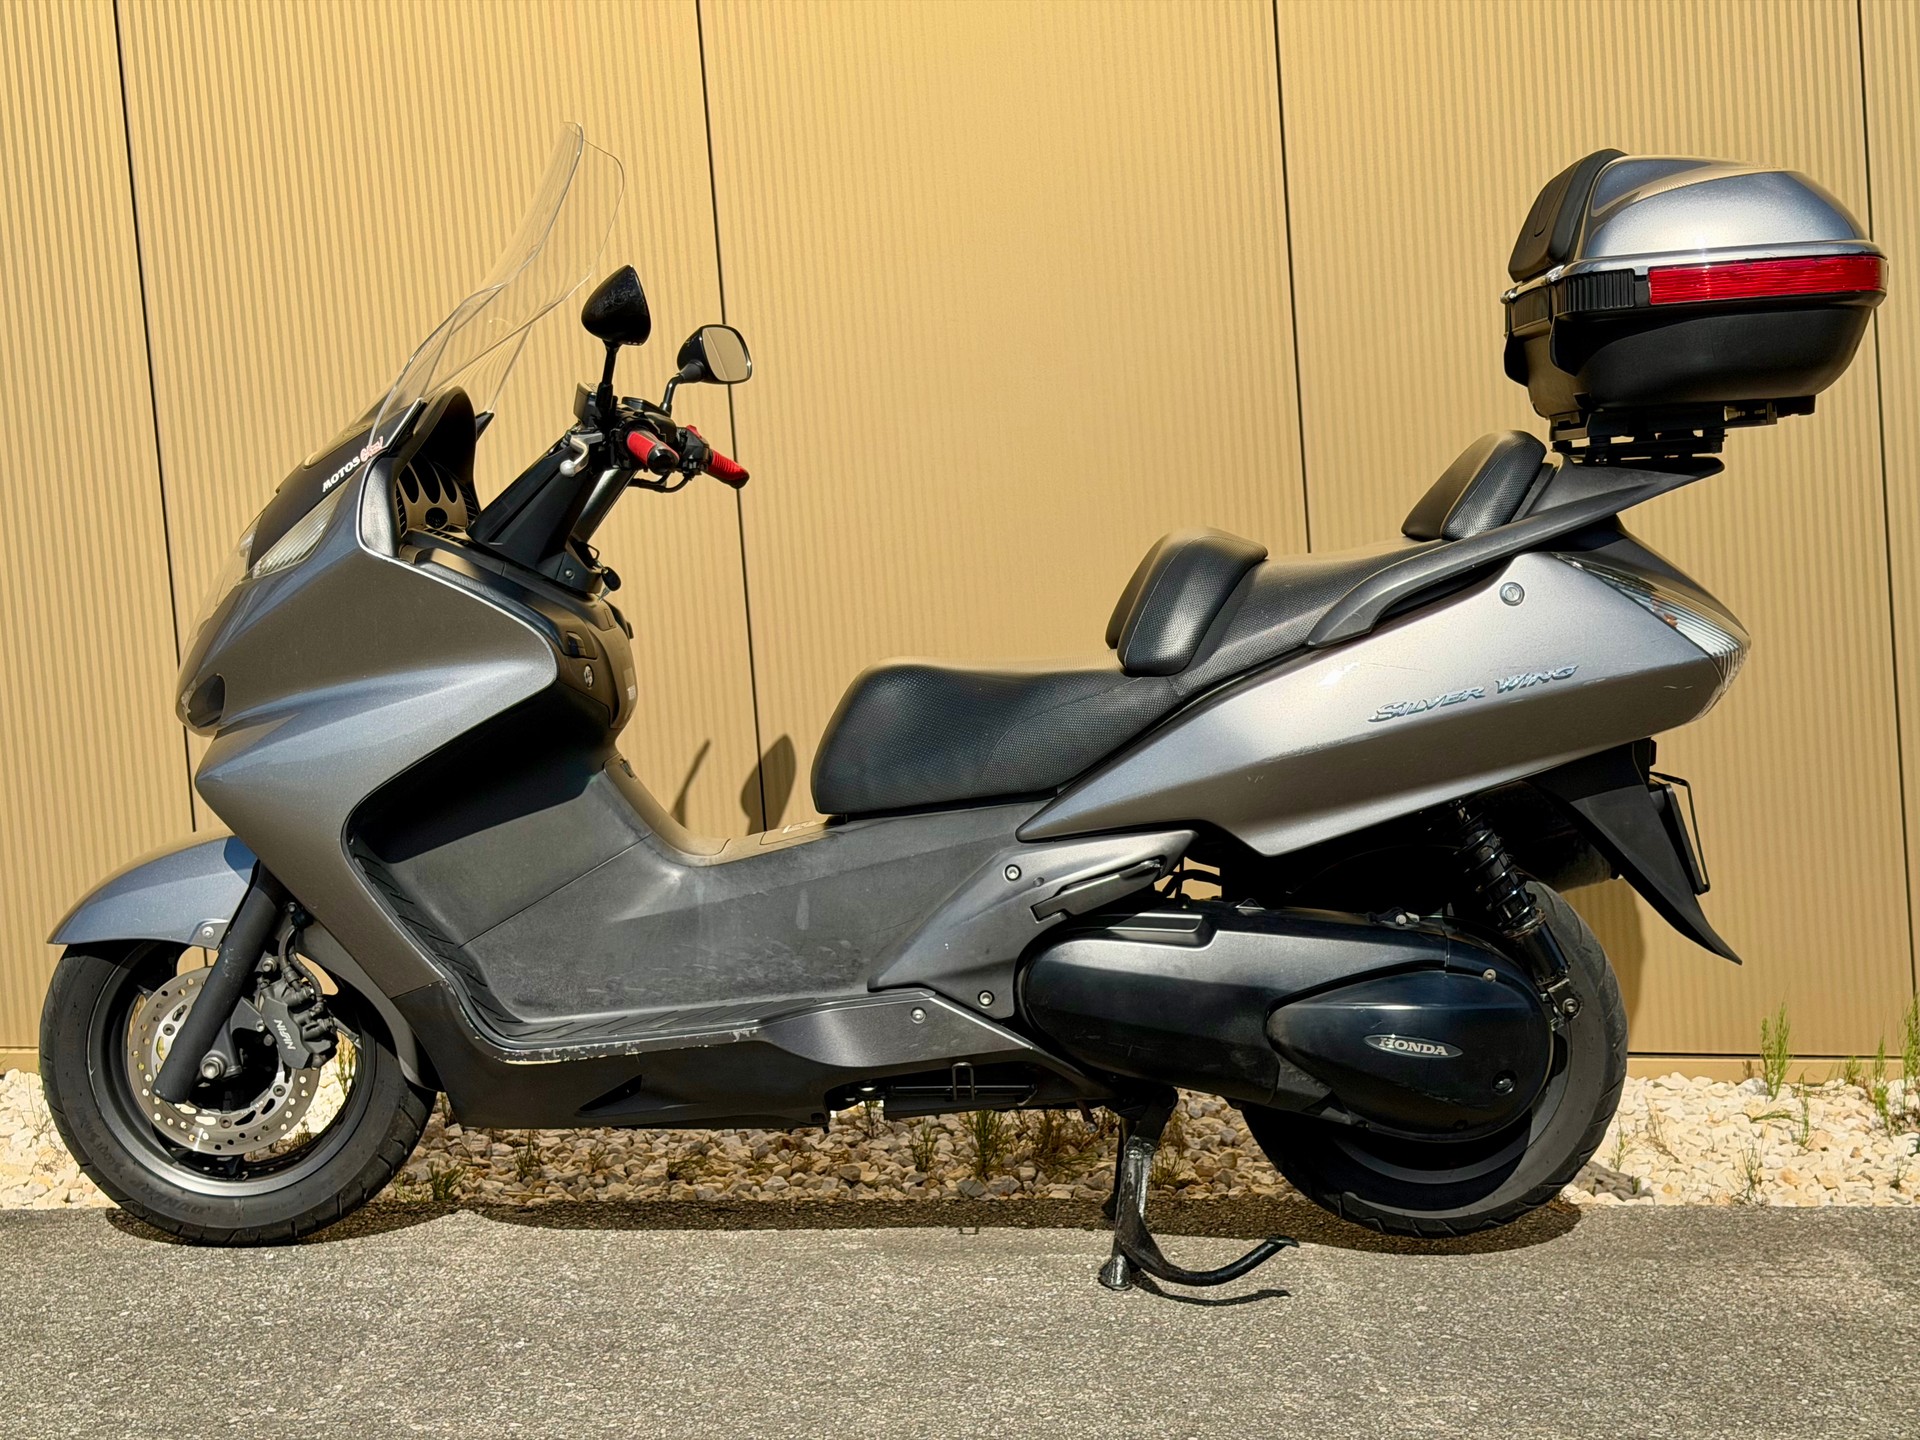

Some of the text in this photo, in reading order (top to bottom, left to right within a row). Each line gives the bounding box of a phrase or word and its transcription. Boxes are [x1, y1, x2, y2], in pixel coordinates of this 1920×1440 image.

[322, 456, 361, 493] MOTOS
[1368, 664, 1579, 722] SILVER WING
[1379, 1037, 1448, 1056] HONDA
